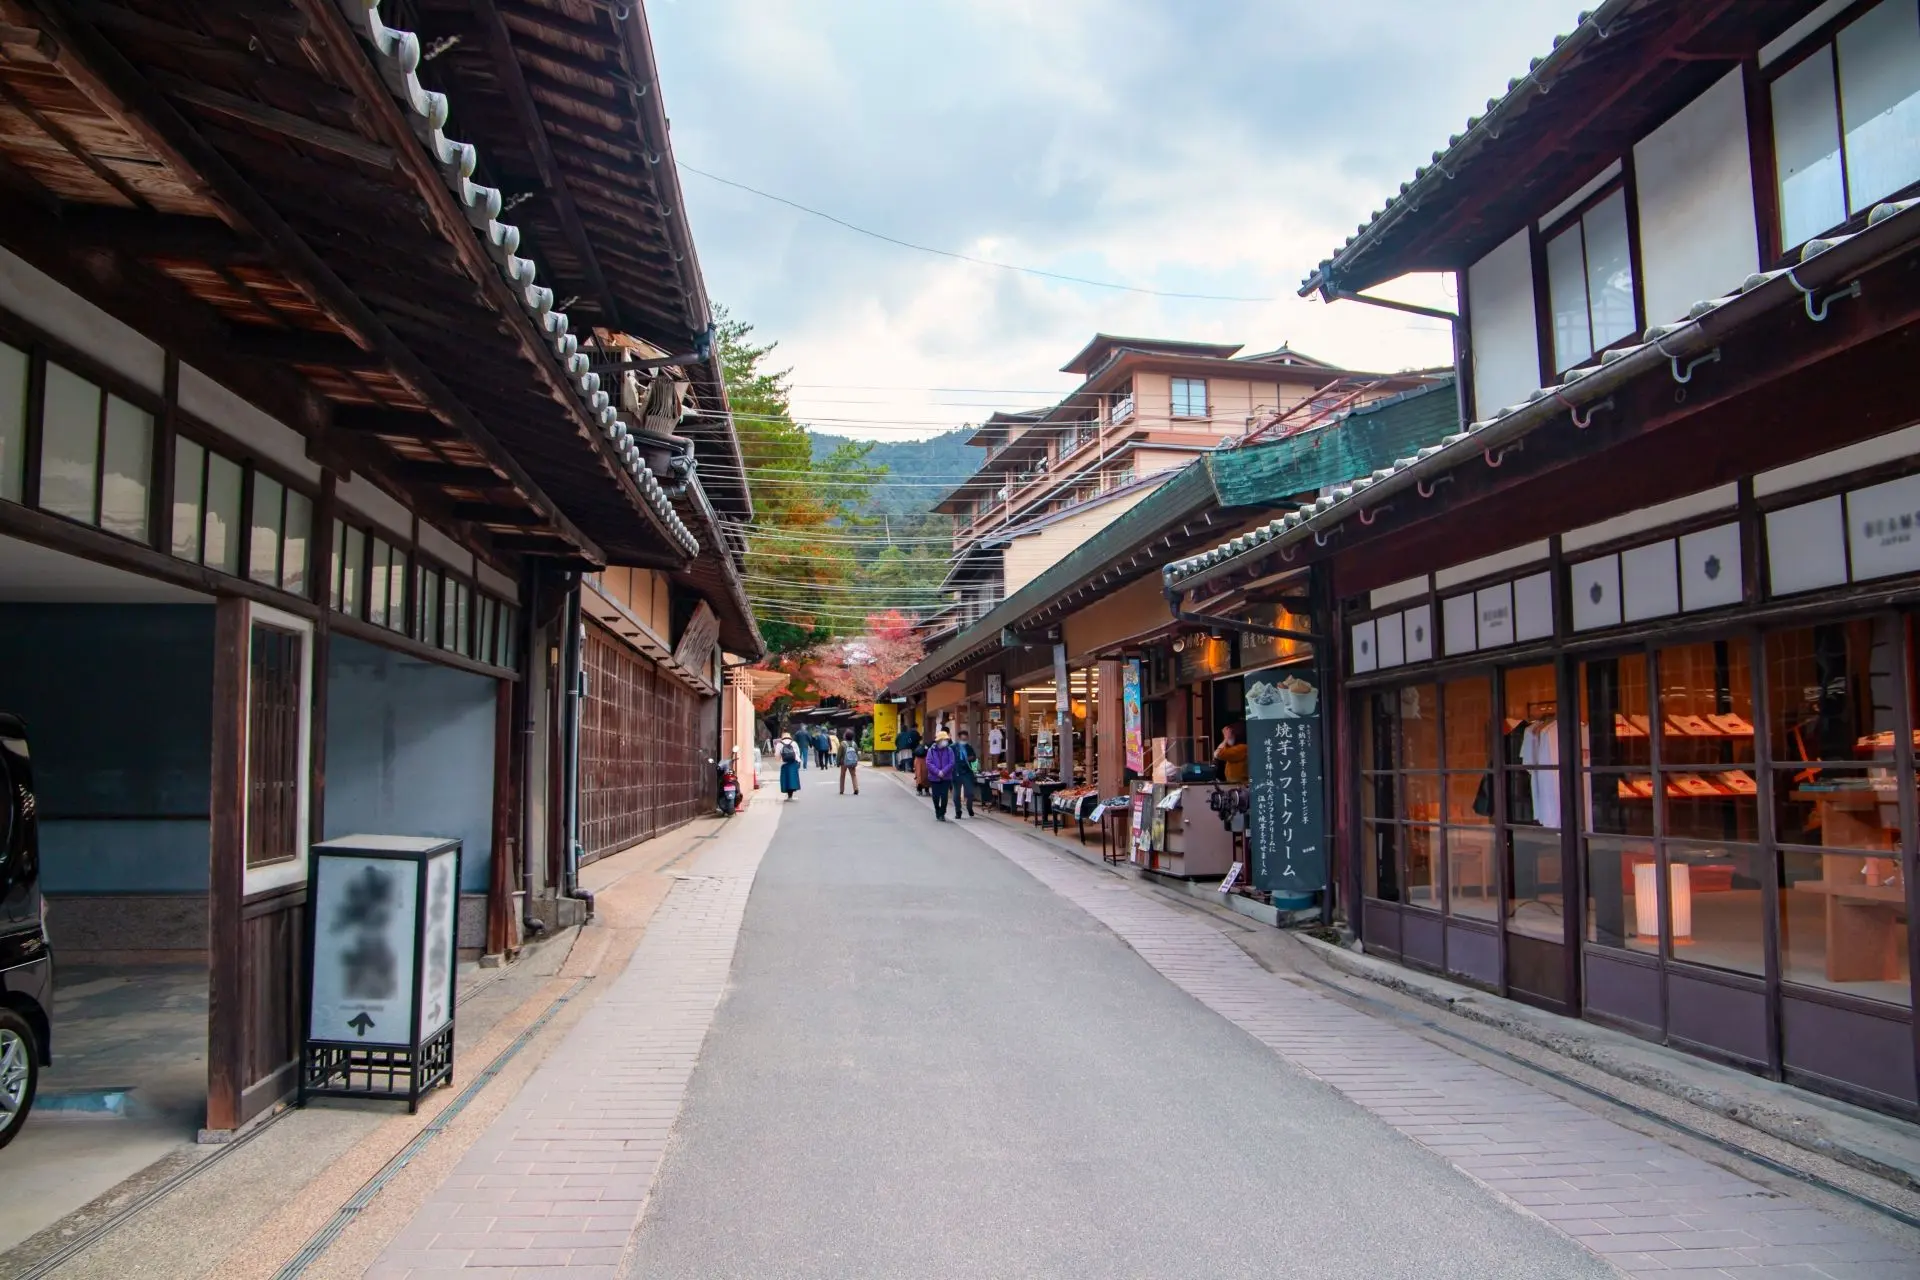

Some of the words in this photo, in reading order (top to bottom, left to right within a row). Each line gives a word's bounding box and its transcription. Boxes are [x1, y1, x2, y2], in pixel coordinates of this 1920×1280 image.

[1275, 722, 1296, 876] 焼芋ソフトクリーム
